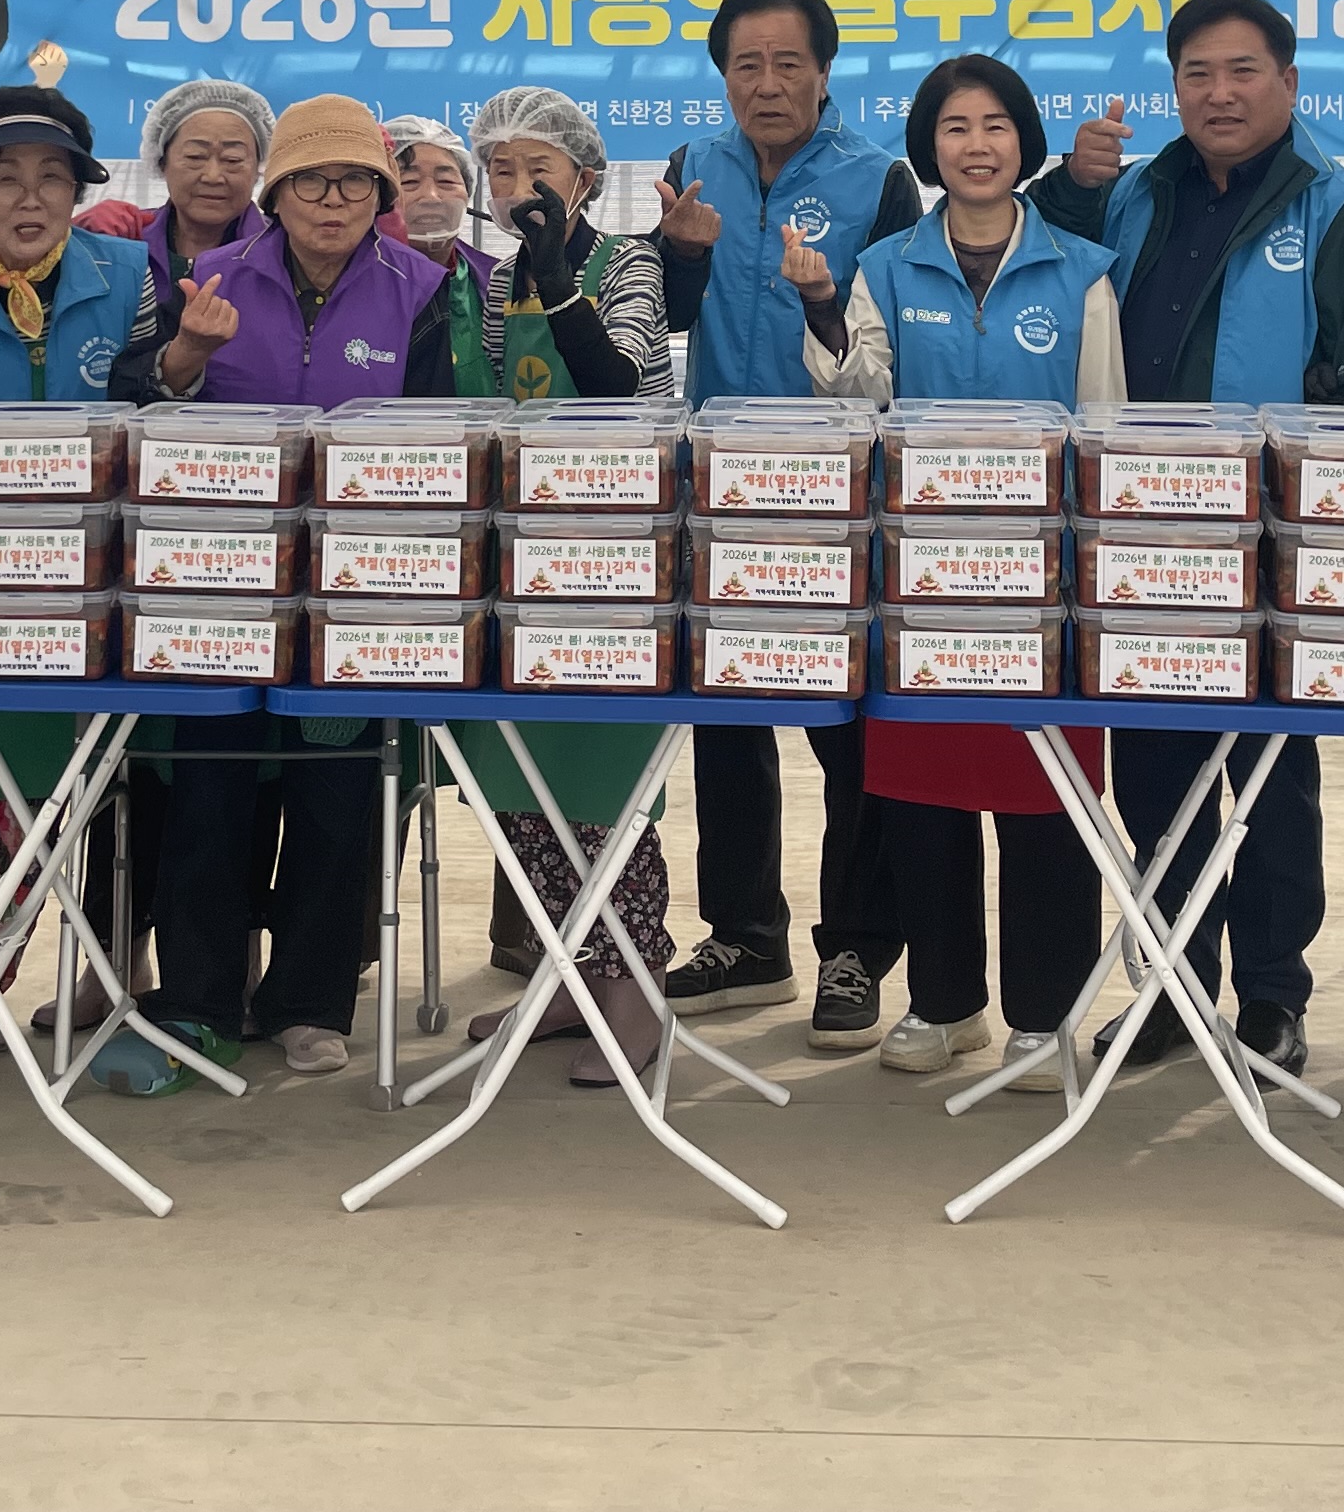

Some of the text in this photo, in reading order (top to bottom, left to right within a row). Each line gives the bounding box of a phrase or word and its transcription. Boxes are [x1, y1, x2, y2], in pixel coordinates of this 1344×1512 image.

[607, 99, 673, 126] 친환경
[681, 99, 726, 125] 공동
[154, 447, 189, 459] 2026년
[340, 451, 375, 463] 2026년
[442, 452, 463, 463] 담은
[530, 454, 565, 465] 2026년
[634, 454, 655, 465] 담은
[721, 458, 756, 470] 2026년
[825, 460, 846, 472] 담은
[915, 454, 951, 466] 2026년
[1021, 455, 1041, 467] 담은
[1114, 460, 1150, 473] 2026년
[1221, 463, 1242, 475] 담은
[527, 545, 562, 557] 2026년
[631, 545, 651, 557] 담은
[913, 544, 949, 557] 2026년
[1019, 546, 1040, 558] 담은
[719, 635, 755, 649] 2026년
[823, 640, 845, 653] 담은
[1114, 639, 1150, 652] 2026년
[1221, 644, 1242, 655] 담은
